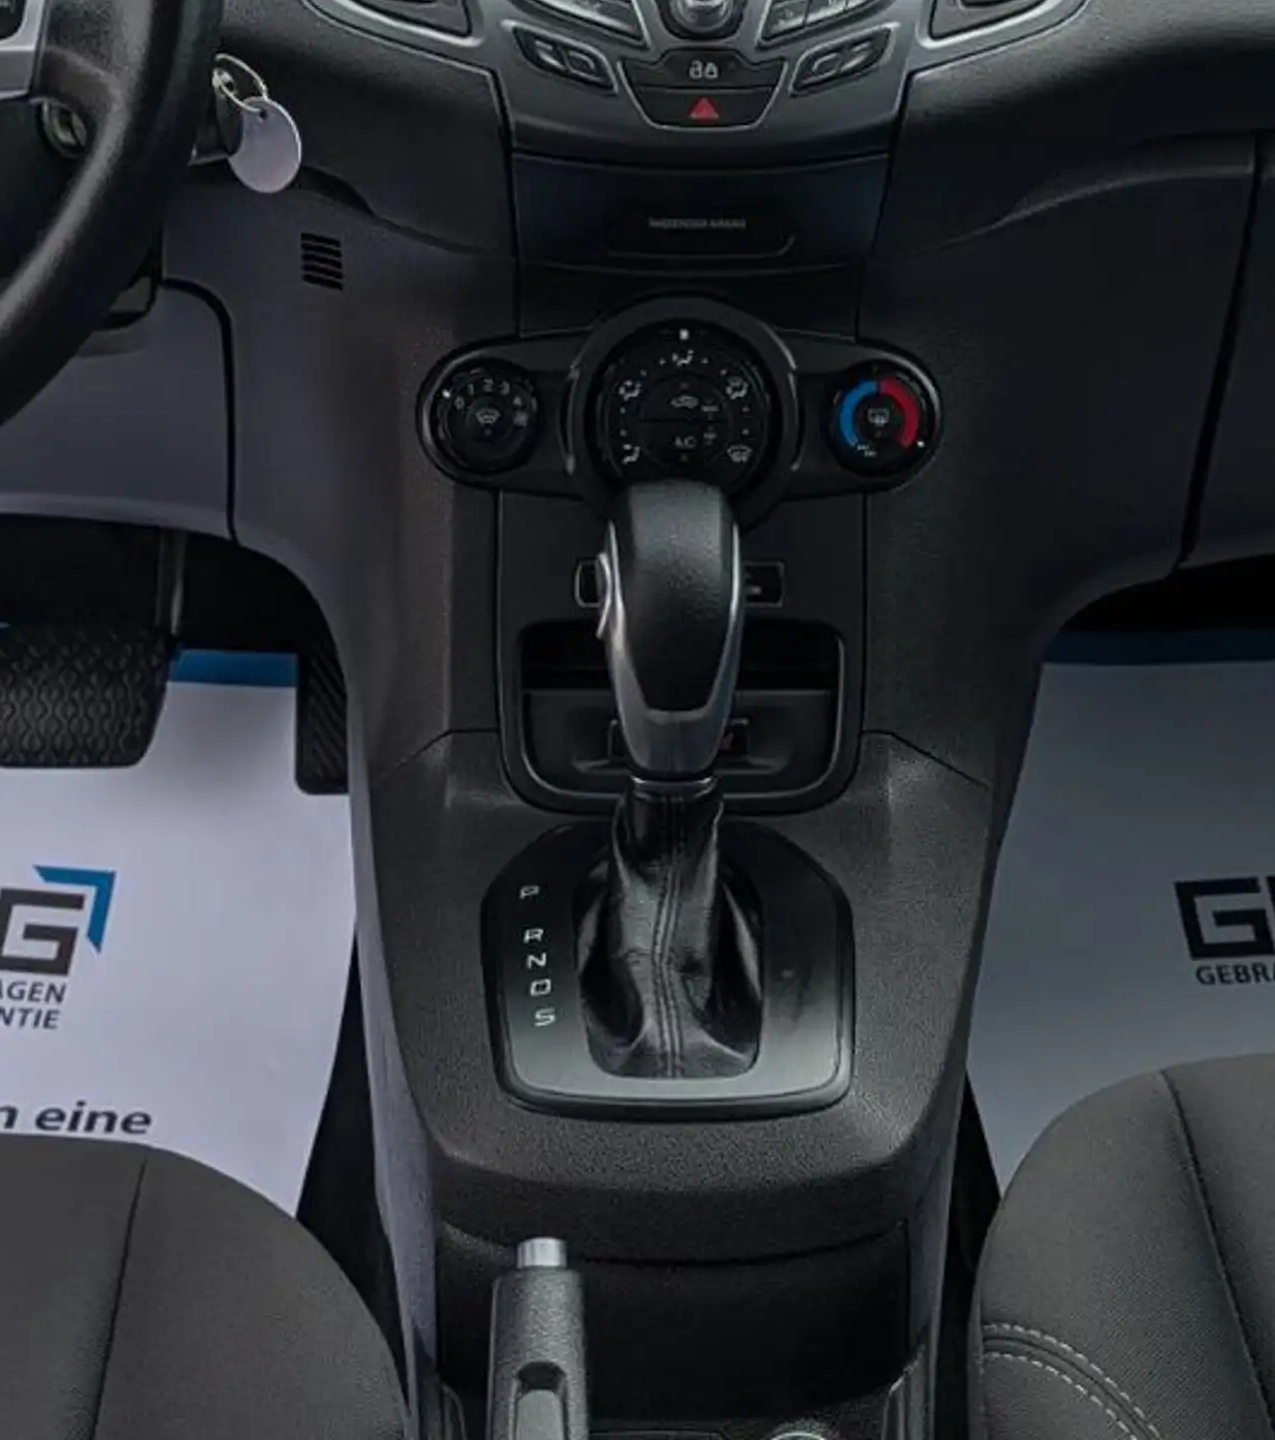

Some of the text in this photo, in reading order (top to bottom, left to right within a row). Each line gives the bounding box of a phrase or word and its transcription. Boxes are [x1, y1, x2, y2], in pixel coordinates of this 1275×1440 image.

[519, 884, 540, 899] P
[523, 928, 544, 943] R
[527, 952, 548, 969] N
[530, 978, 552, 997] D
[534, 1008, 557, 1027] S
[34, 1100, 152, 1134] eine
